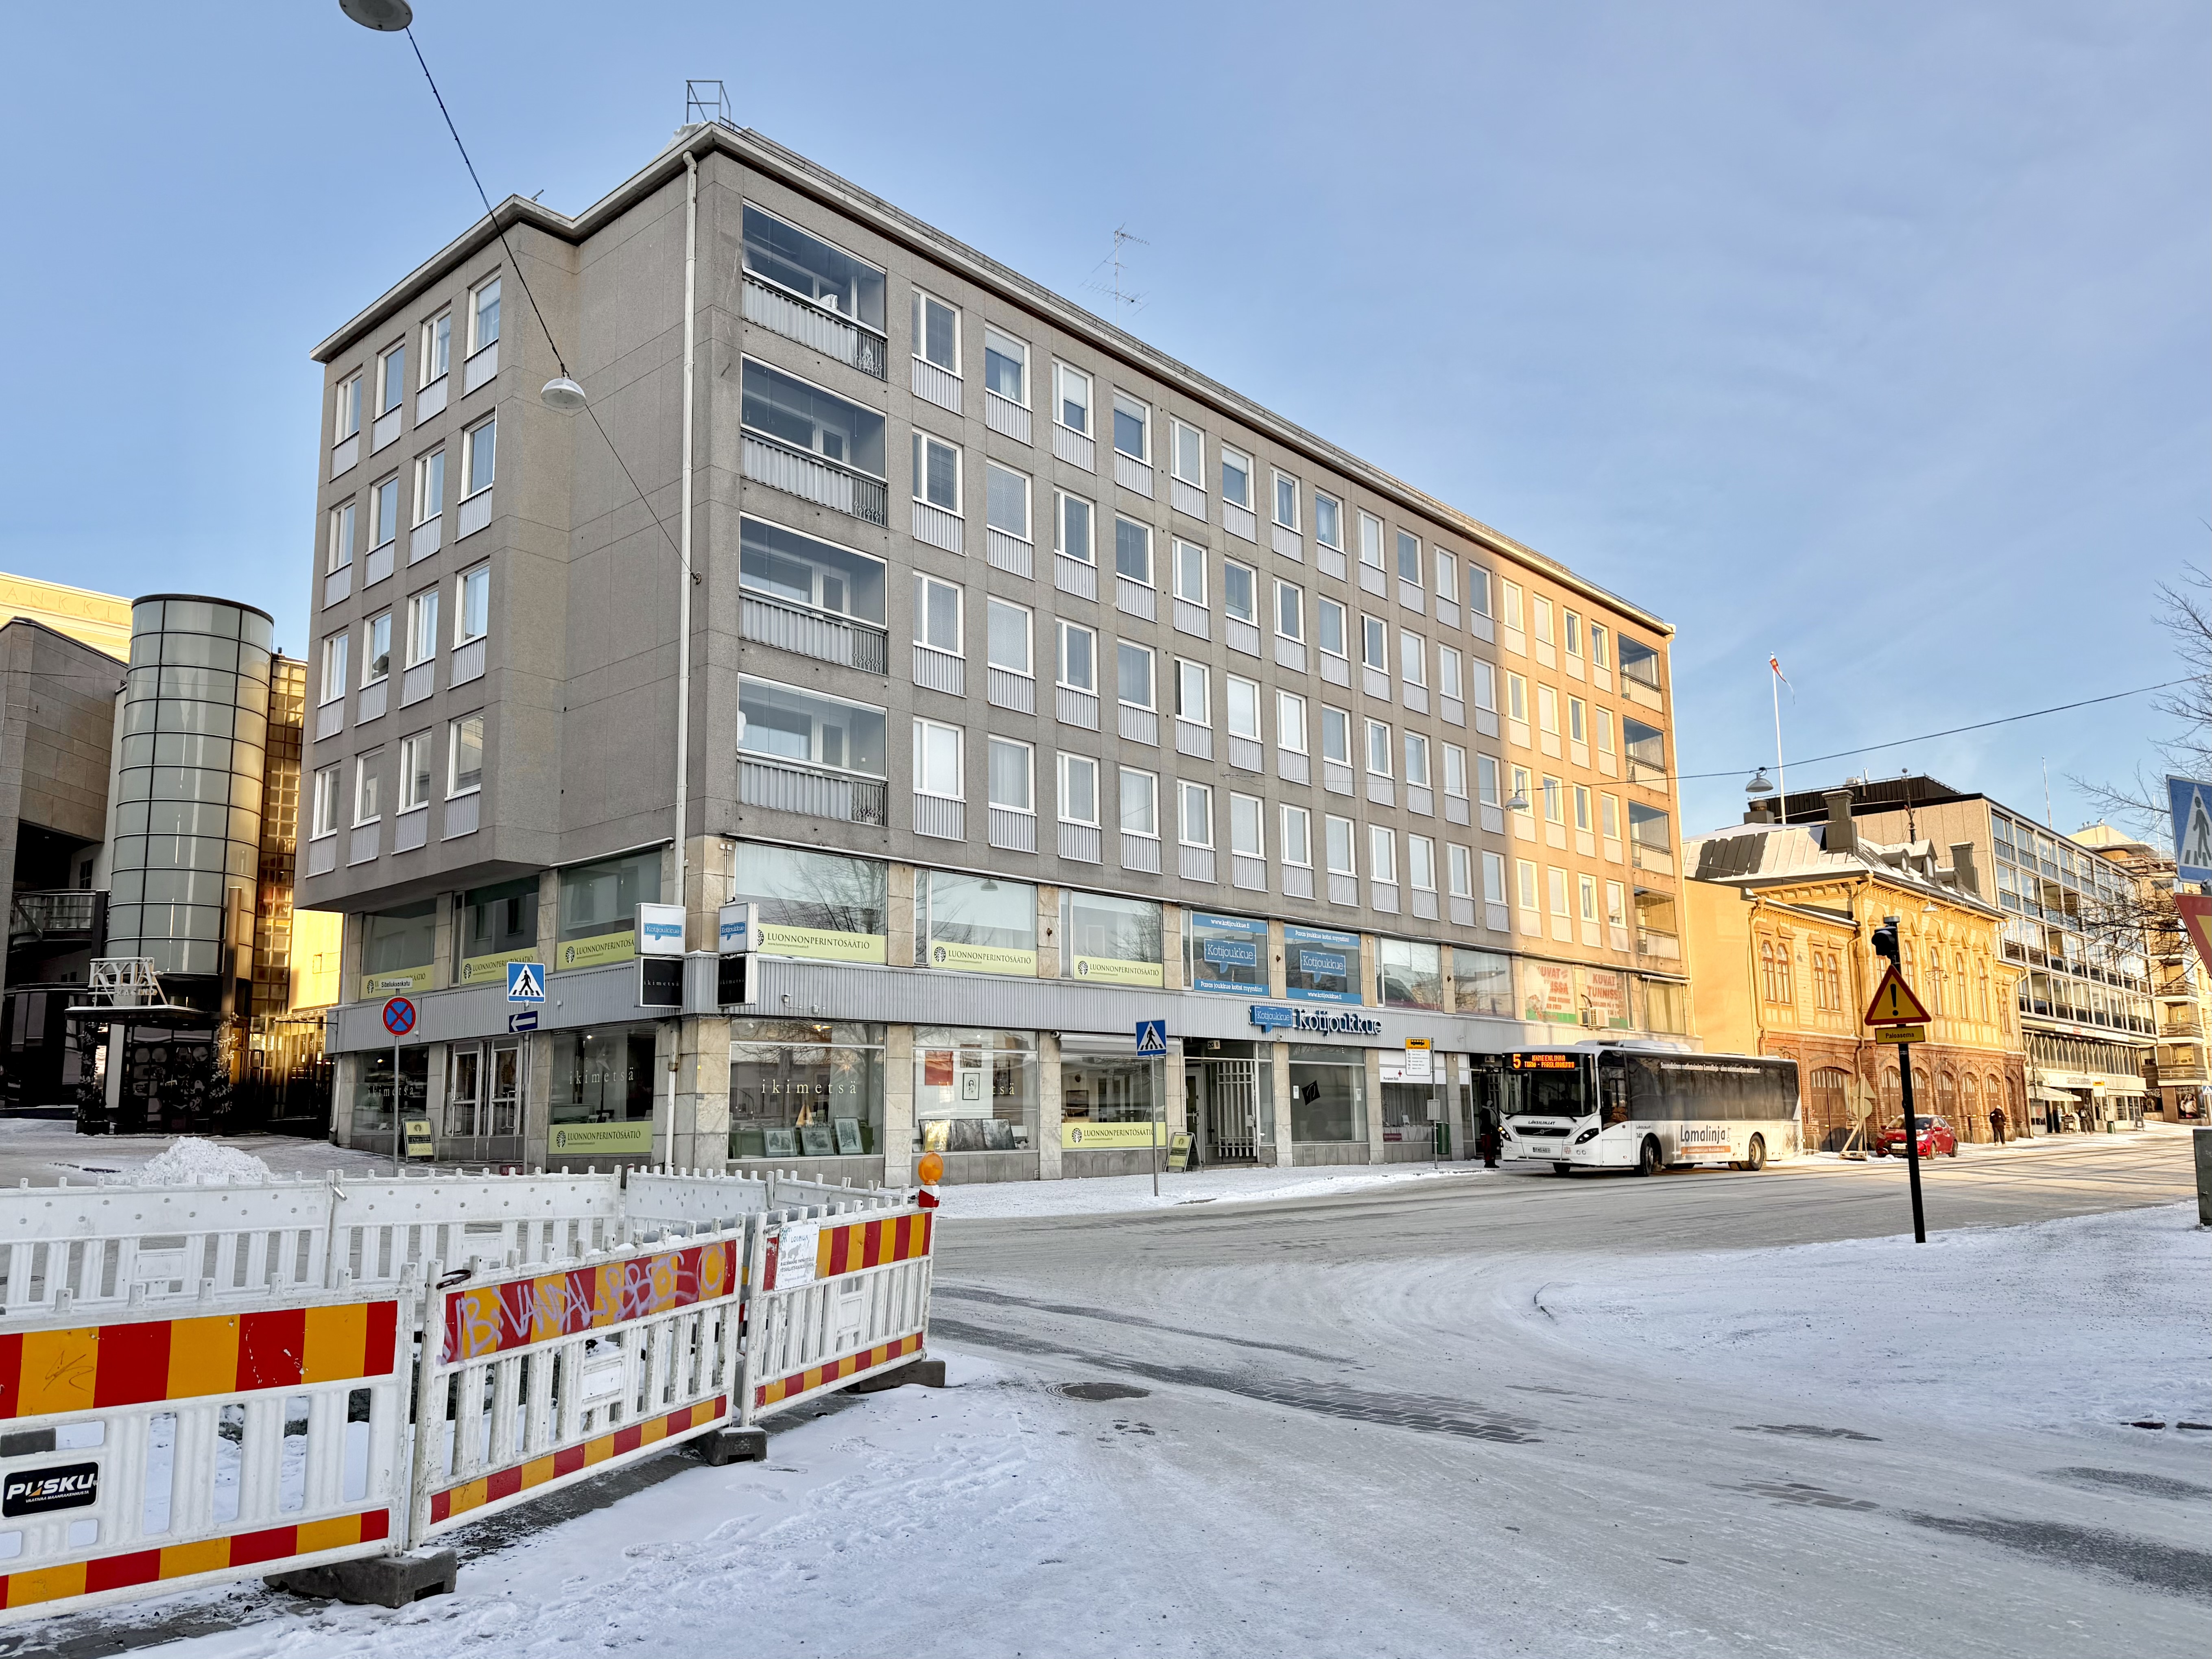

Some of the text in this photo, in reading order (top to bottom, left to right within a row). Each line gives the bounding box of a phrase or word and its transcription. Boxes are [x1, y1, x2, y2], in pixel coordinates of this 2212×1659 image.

[646, 926, 680, 934] Kotijoukkue
[1210, 919, 1250, 929] www.kotijoukkue.fi
[767, 932, 870, 949] LUONNONPERINTÖSÄÄTIÖ
[948, 950, 1031, 964] LUONNONPERINTÖSÄÄTIÖ
[1207, 944, 1253, 960] Kotijoukkue
[1090, 963, 1159, 976] LUONNONPERINTÖSÄÄTIÖ
[1303, 956, 1343, 970] Kotijoukkue
[1592, 973, 1616, 986] KUVAT
[116, 988, 158, 997] KASINO
[1587, 985, 1623, 1001] TUNNISSA
[1257, 1011, 1290, 1022] Kotijoukkue
[1296, 1009, 1382, 1036] Kotijoukkue
[1513, 1054, 1521, 1069] 5
[570, 1067, 634, 1085] ikimetsä
[761, 1079, 856, 1094] ikimetsä
[568, 1129, 641, 1141] LUONNONPERINTÖSÄÄTIÖ
[1680, 1124, 1725, 1144] Lomalinja
[6, 1473, 95, 1500] PUSKU
[47, 1490, 89, 1500] MAANRAKENNUSTA
